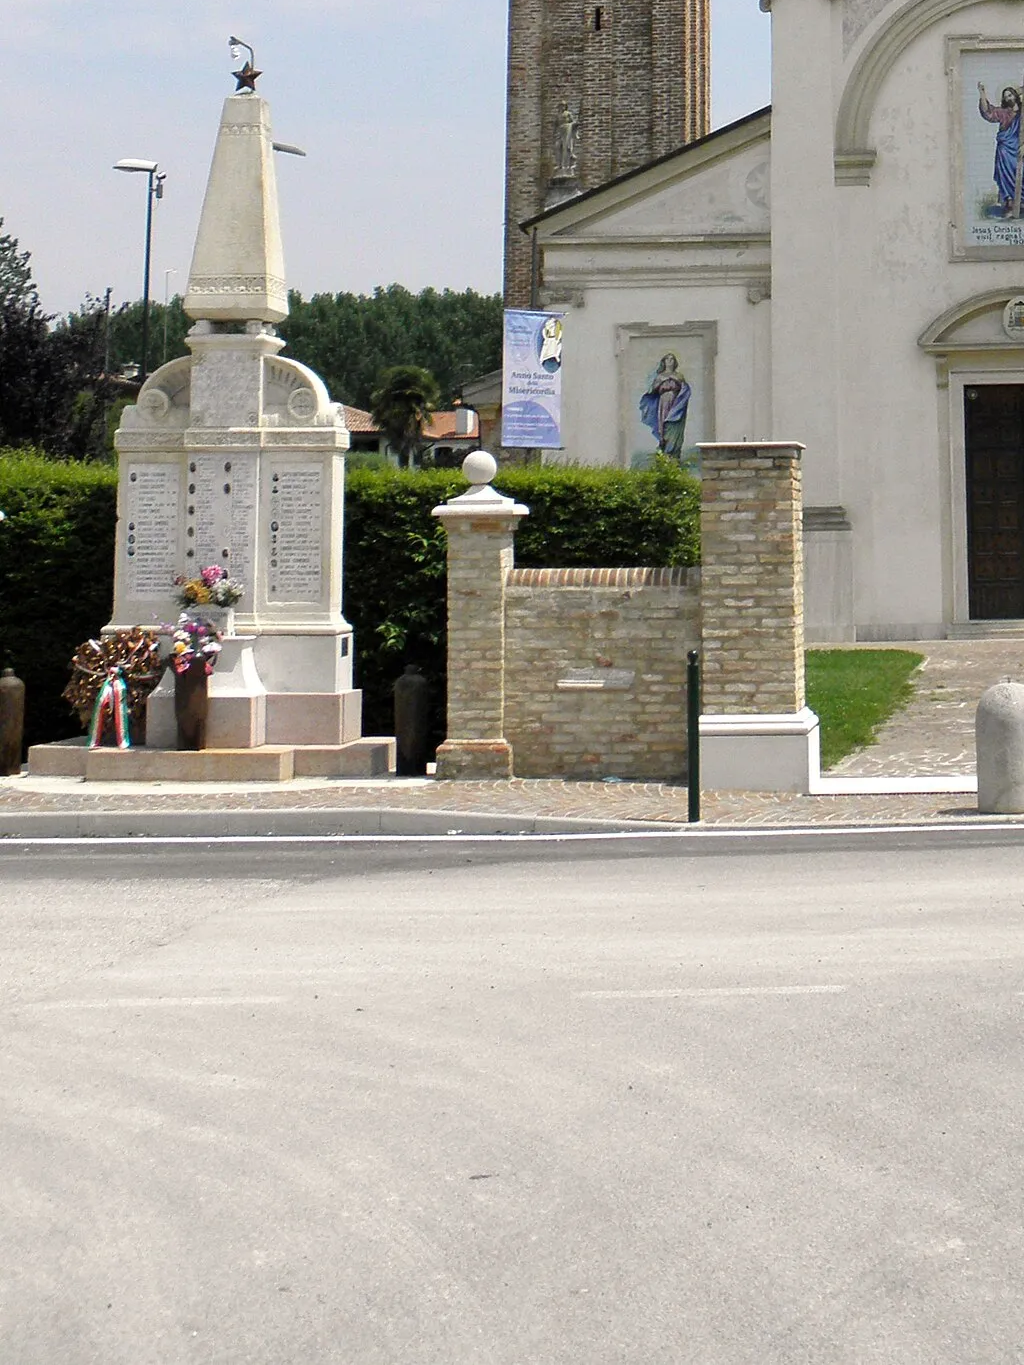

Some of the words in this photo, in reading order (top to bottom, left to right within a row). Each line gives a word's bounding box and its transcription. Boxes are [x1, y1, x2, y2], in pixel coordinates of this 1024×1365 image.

[972, 226, 991, 234] Jesus
[994, 225, 1022, 234] Christus
[511, 371, 532, 379] Anno
[532, 372, 554, 380] Santo
[508, 386, 556, 395] Misericordia
